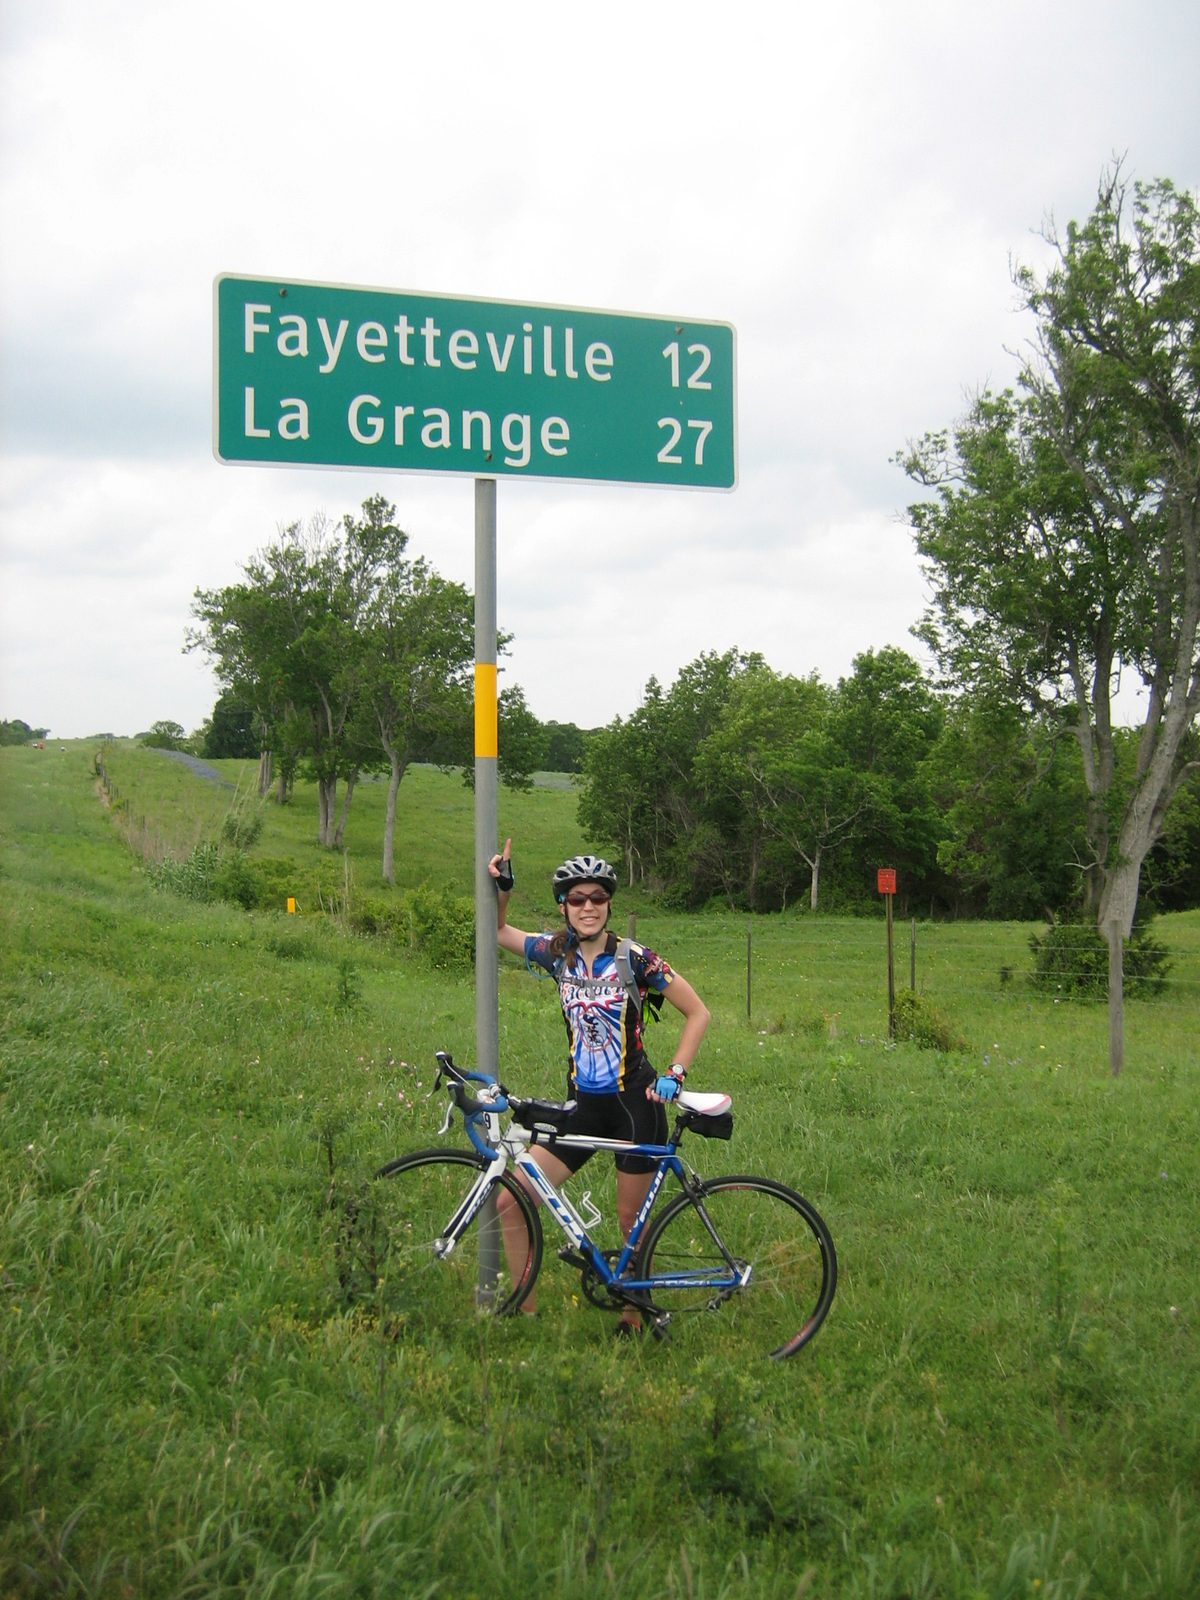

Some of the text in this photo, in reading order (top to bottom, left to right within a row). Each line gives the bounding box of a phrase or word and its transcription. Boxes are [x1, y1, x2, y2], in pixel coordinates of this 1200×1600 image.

[244, 302, 713, 391] Fayetteville 12
[244, 386, 713, 468] La Grange 27
[638, 1170, 664, 1223] FUJI
